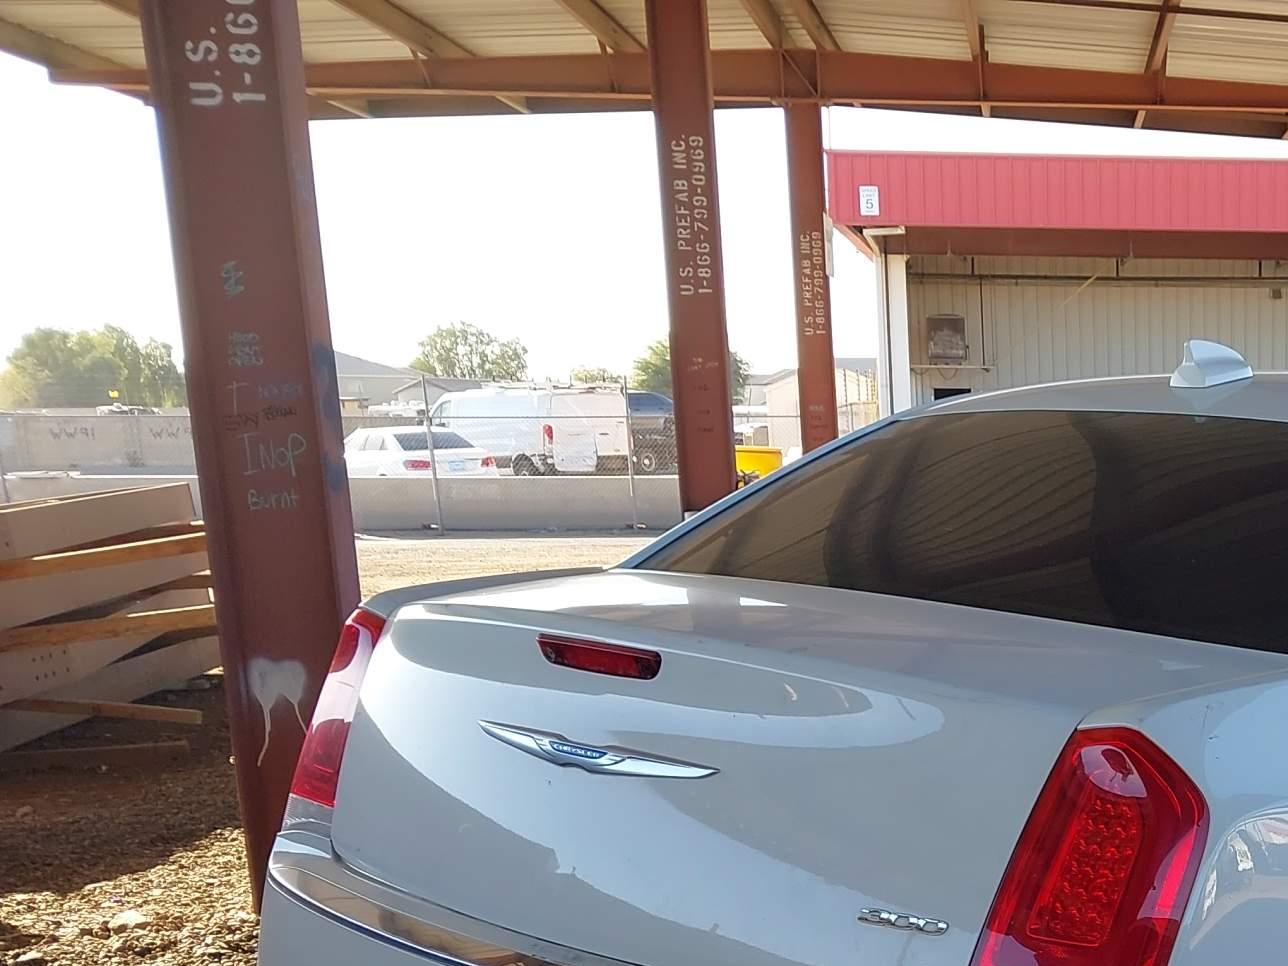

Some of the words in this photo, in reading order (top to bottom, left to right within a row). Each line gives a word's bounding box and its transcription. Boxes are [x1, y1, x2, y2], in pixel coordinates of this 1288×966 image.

[185, 26, 223, 106] U.S.
[224, 0, 267, 104] 1-86
[670, 133, 688, 169] INC.
[672, 179, 693, 251] PREFAB
[688, 135, 713, 294] 1-866-799-0969
[865, 198, 874, 209] 5
[800, 230, 811, 254] INC.
[679, 261, 695, 296] U.S.
[801, 259, 813, 307] PREFAB
[804, 312, 815, 336] U.S.
[247, 488, 299, 511] Burnt
[858, 908, 949, 936] 300
